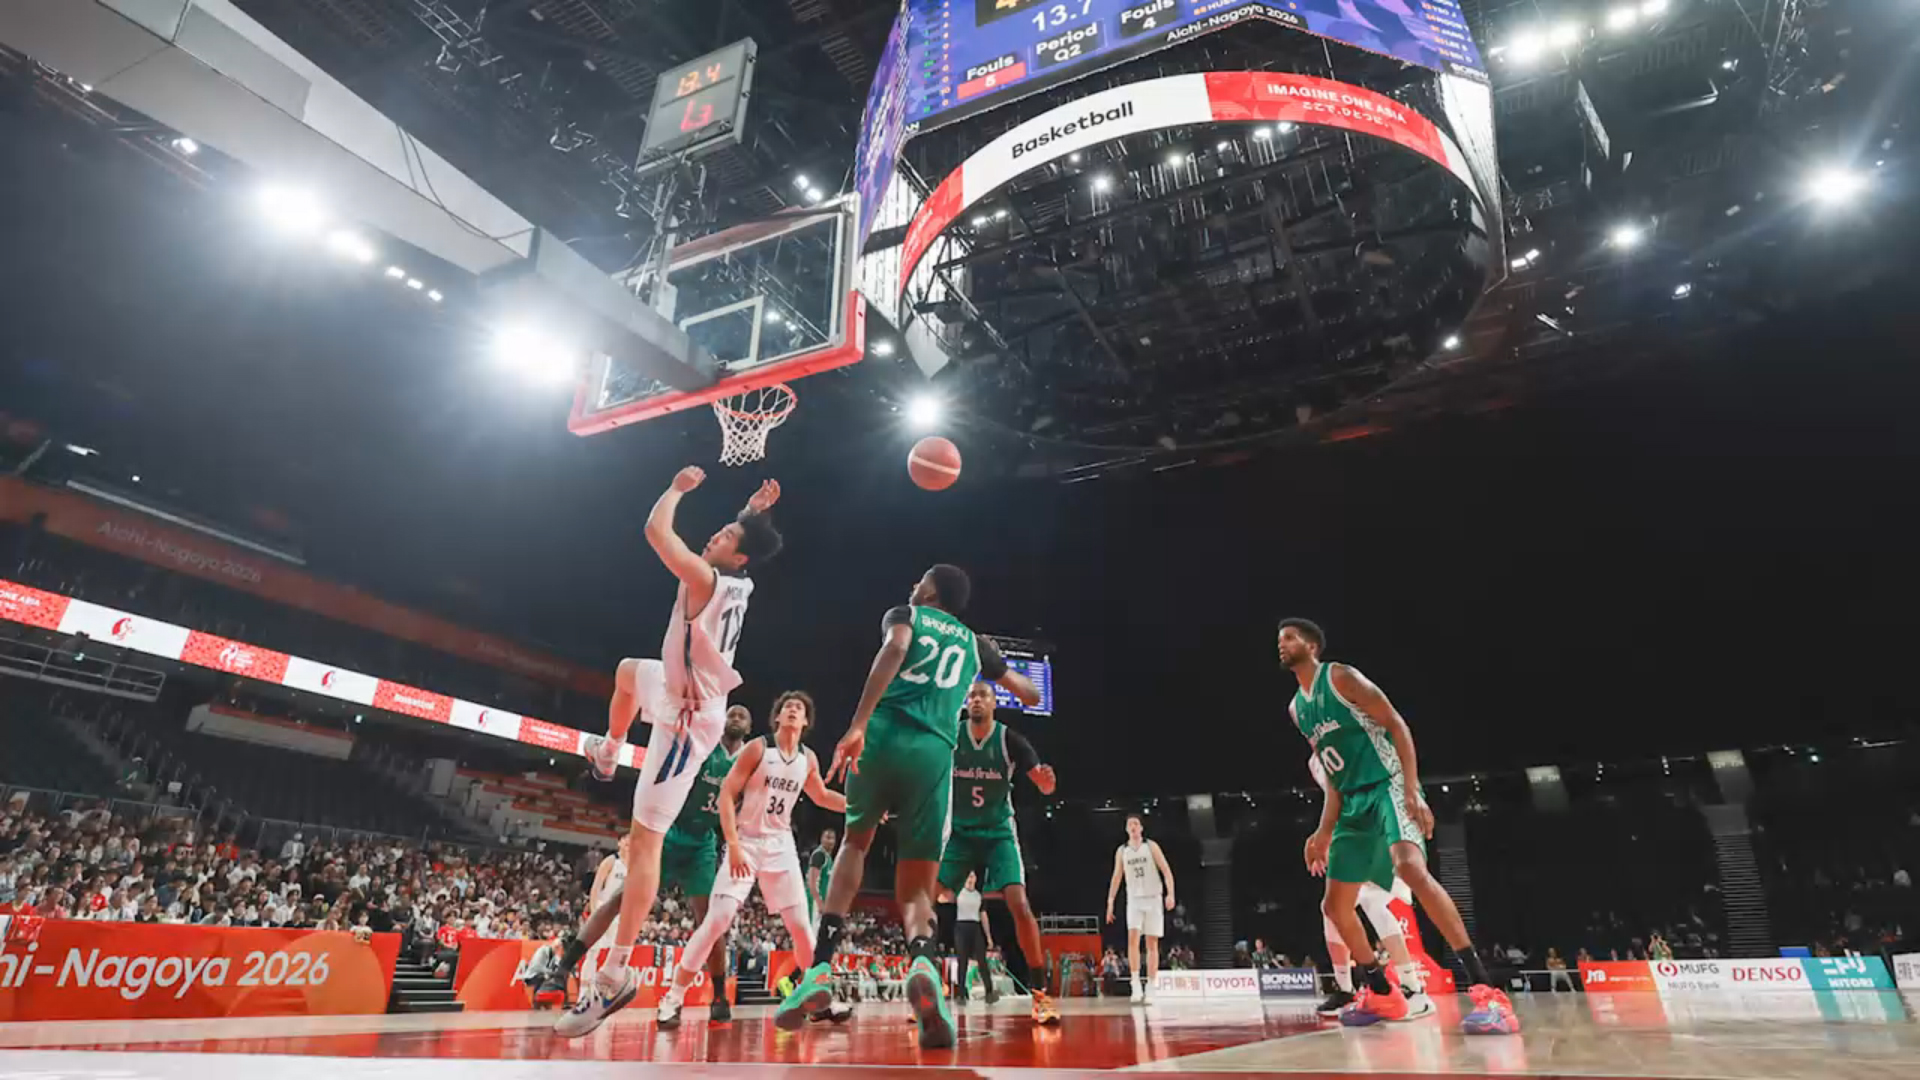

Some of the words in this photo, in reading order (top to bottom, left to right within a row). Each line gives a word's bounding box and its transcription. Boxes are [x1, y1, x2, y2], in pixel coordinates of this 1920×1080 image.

[1032, 0, 1092, 31] 13.7
[1121, 0, 1175, 24] Fouls
[1142, 17, 1156, 29] 4
[1166, 5, 1264, 42] Aichi-Nagoya
[1265, 7, 1298, 24] 2026
[1036, 22, 1098, 55] Period
[1054, 44, 1082, 62] Q2
[967, 56, 1014, 81] Fouls
[1267, 84, 1339, 102] IMAGINE
[1341, 94, 1373, 111] ONE
[1376, 105, 1408, 124] ASIA
[1011, 101, 1134, 160] Basketball
[97, 521, 218, 569] Aichi-Nagoya
[900, 635, 966, 689] 20
[764, 775, 799, 793] KOREA
[766, 796, 785, 815] 36
[972, 786, 985, 807] 5
[237, 950, 330, 986] 2026
[1261, 973, 1313, 985] BORNAN
[1680, 963, 1719, 974] MUFG
[1731, 966, 1802, 982] DENSO
[1206, 977, 1256, 988] TOYOTA
